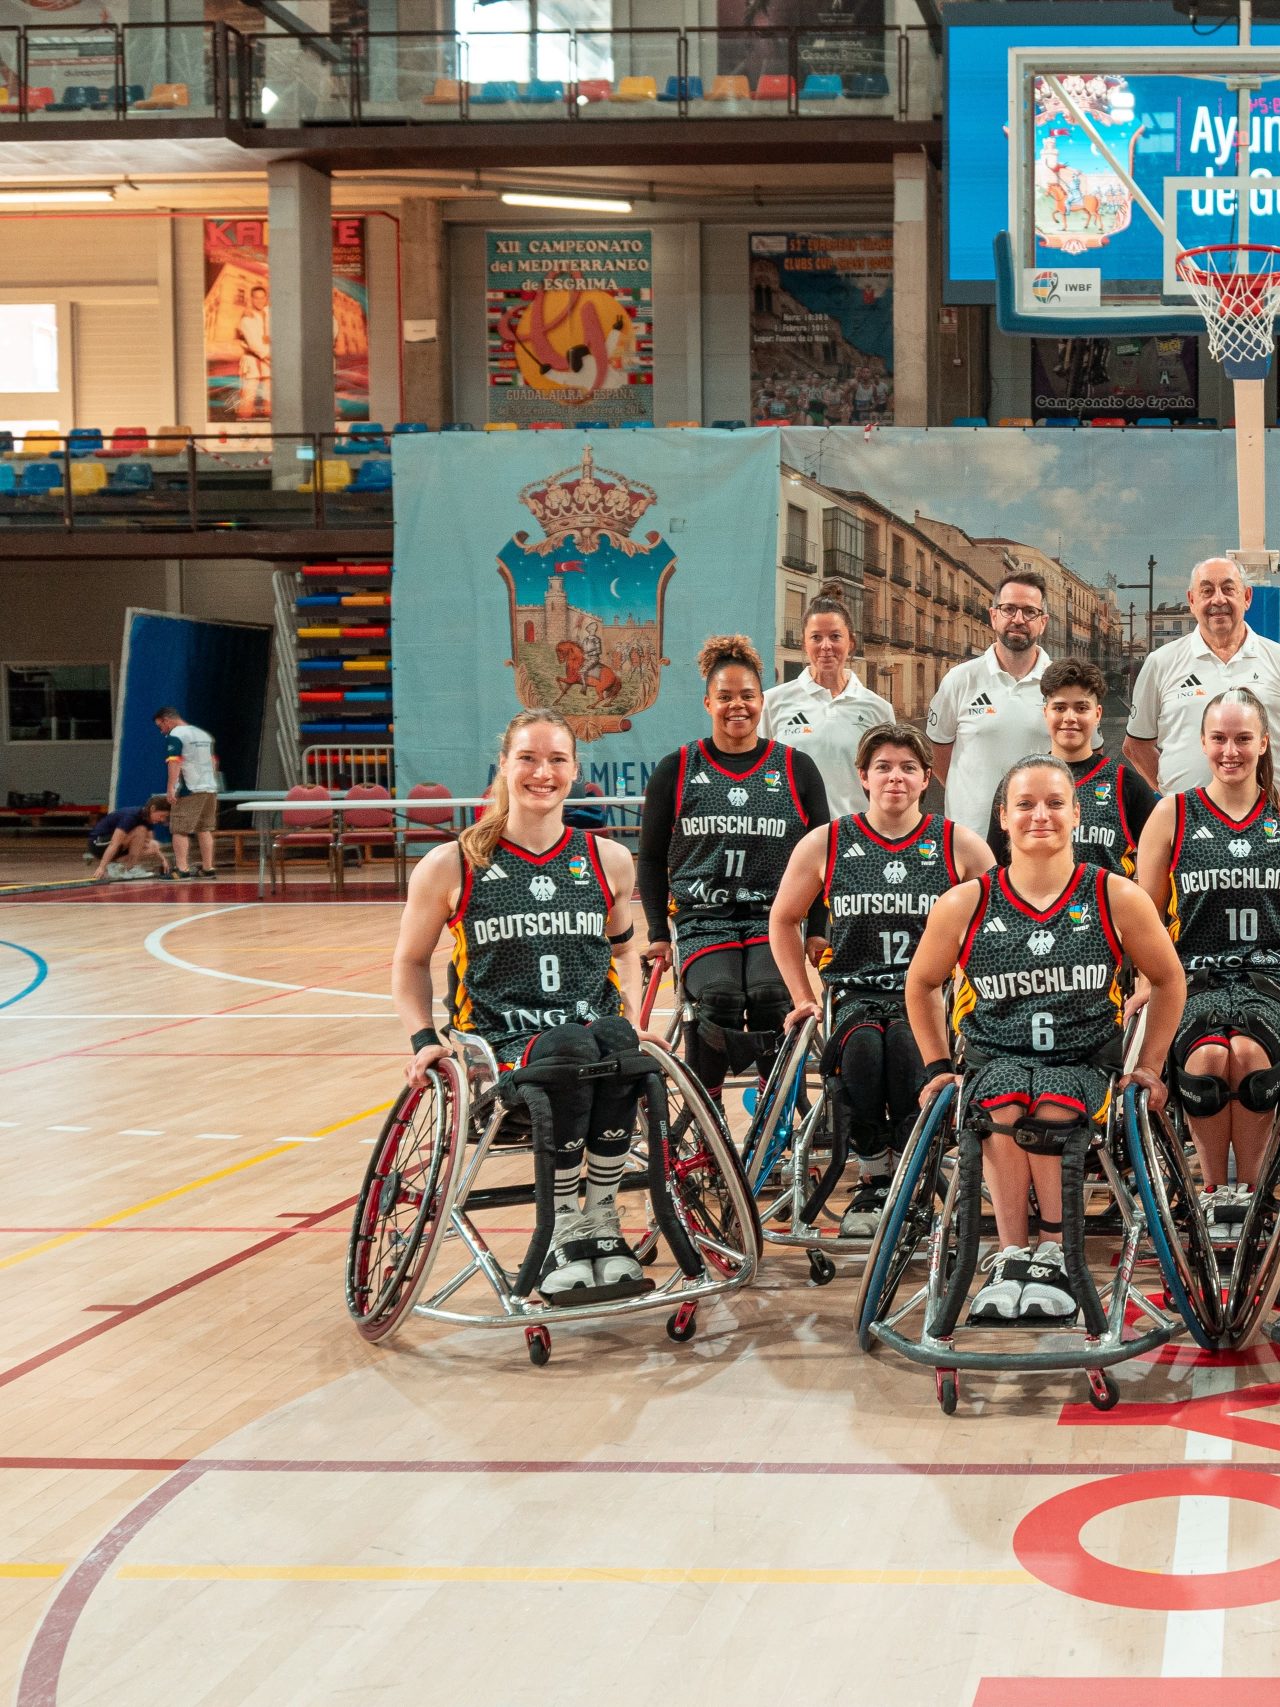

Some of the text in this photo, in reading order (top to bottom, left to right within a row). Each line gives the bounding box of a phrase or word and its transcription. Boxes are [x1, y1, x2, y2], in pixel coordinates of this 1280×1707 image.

[496, 240, 643, 253] XII CAMPEONATO
[490, 259, 649, 272] del MEDITERRANEO
[522, 278, 618, 291] de ESGRIMA
[1065, 283, 1093, 292] IWBF
[506, 389, 584, 400] GUADALAJARA
[1036, 395, 1195, 411] Campeonato de España
[1177, 691, 1196, 699] ING
[681, 815, 786, 838] DEUTSCHLAND
[724, 850, 746, 878] 11
[474, 911, 604, 945] DEUTSCHLAND
[1225, 908, 1258, 941] 10
[878, 931, 910, 965] 12
[539, 954, 561, 993] 8
[973, 964, 1107, 1001] DEUTSCHLAND
[501, 1008, 569, 1033] ING
[1031, 1012, 1054, 1051] 6
